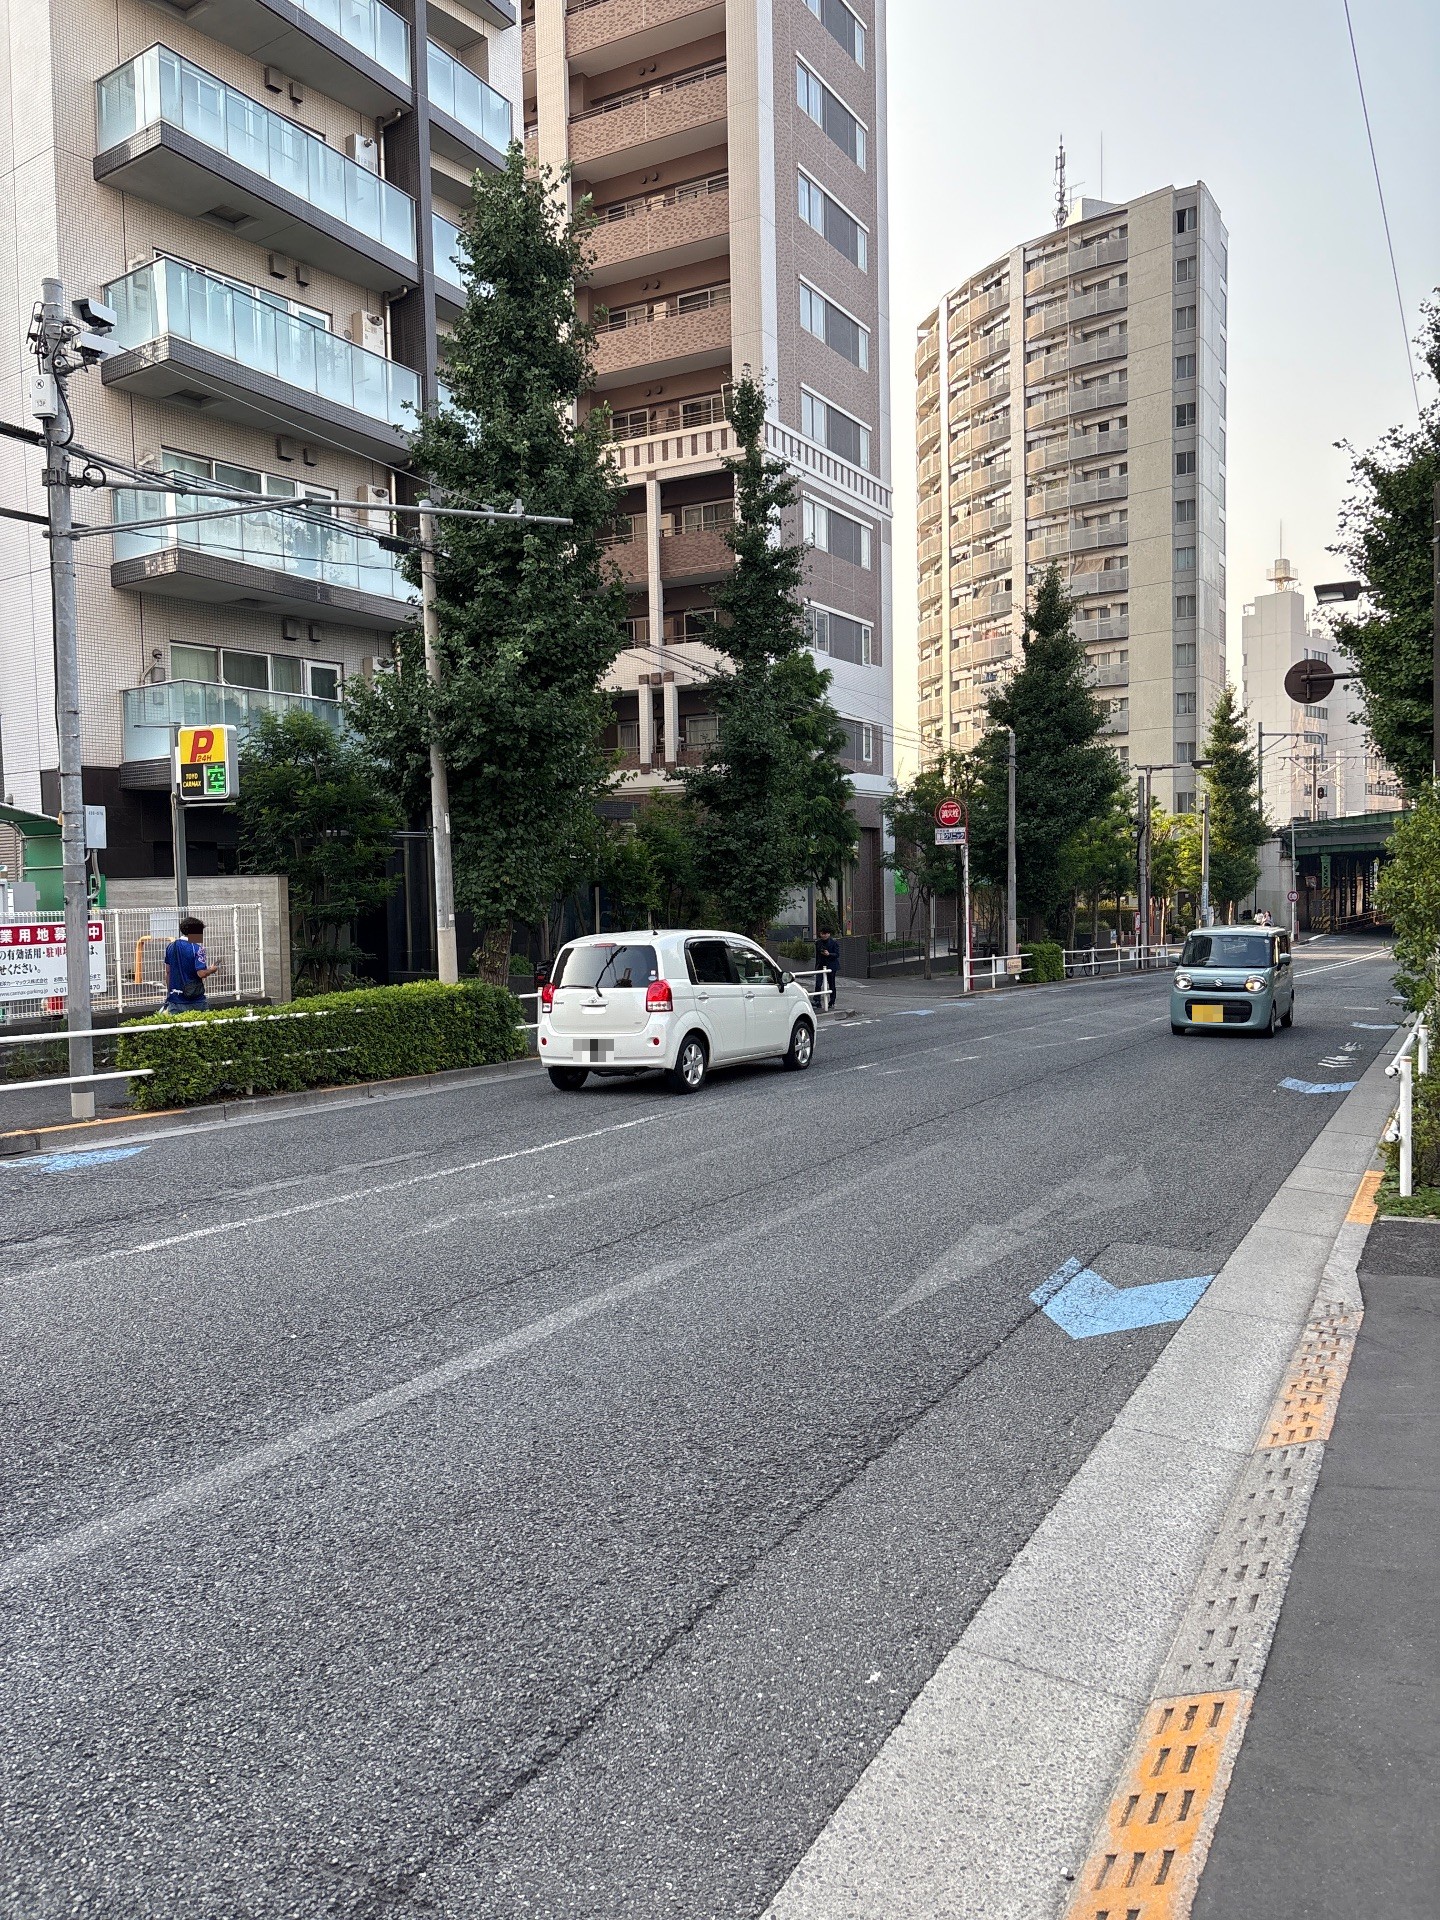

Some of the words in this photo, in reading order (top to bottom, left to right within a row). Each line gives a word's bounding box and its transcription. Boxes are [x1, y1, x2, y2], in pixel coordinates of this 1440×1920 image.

[190, 730, 214, 762] P
[208, 765, 225, 792] 空
[941, 808, 959, 818] 消火栓
[0, 925, 100, 943] 業用地募中
